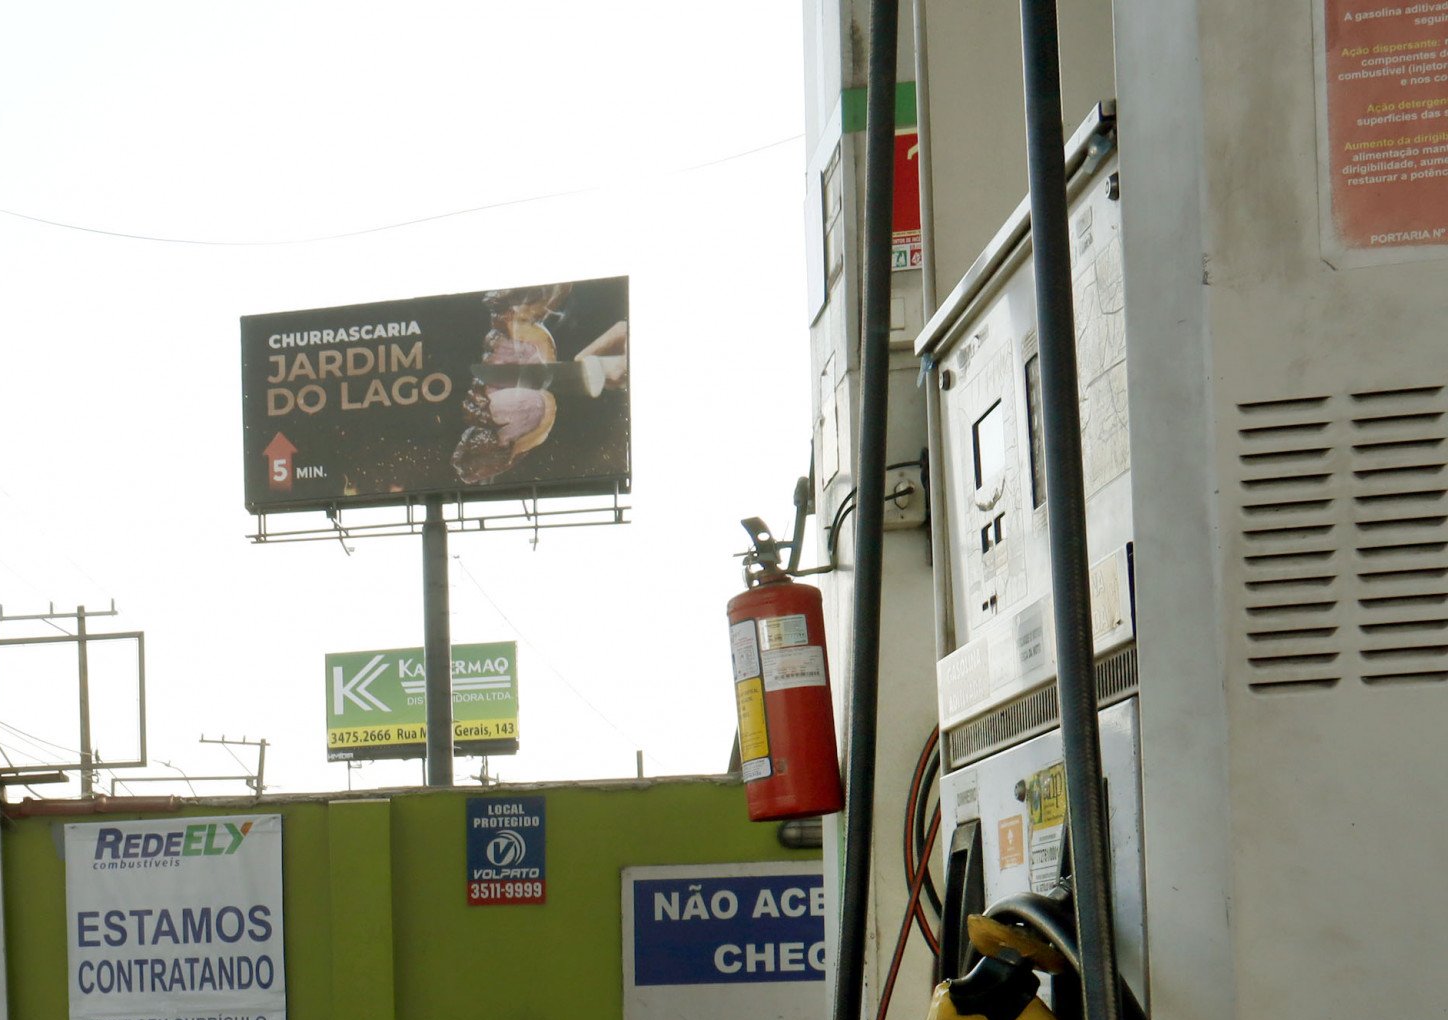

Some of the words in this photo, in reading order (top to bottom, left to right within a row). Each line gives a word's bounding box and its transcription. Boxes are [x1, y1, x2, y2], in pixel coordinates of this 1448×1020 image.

[1344, 12, 1353, 21] A
[1355, 8, 1402, 22] gasolina
[1341, 46, 1370, 57] Ação
[1361, 51, 1436, 66] componentes
[1410, 76, 1431, 85] nos
[1421, 109, 1441, 119] das
[1344, 138, 1394, 151] Aumento
[1397, 136, 1411, 145] da
[1352, 147, 1419, 162] alimentação
[1347, 173, 1397, 186] restaurar
[1401, 172, 1408, 181] a
[1370, 231, 1431, 245] PORTARIA
[268, 320, 422, 350] CHURRASCARIA
[267, 341, 424, 384] JARDIM
[267, 387, 327, 416] DO
[341, 372, 452, 411] LAGO
[273, 459, 288, 482] 5
[296, 464, 328, 480] MIN.
[486, 692, 512, 702] LTDA
[331, 731, 391, 745] 3475.2666
[397, 728, 417, 740] Rua
[454, 725, 492, 738] Gerais,
[495, 722, 514, 735] 143
[488, 804, 525, 815] LOCAL
[473, 816, 540, 828] PROTEGIDO
[92, 858, 181, 870] combustíveis
[473, 868, 540, 880] VOLPATO
[471, 882, 542, 899] 3511-9999
[654, 885, 739, 922] NÃO
[77, 905, 273, 948] ESTAMOS
[78, 955, 274, 995] CONTRATANDO
